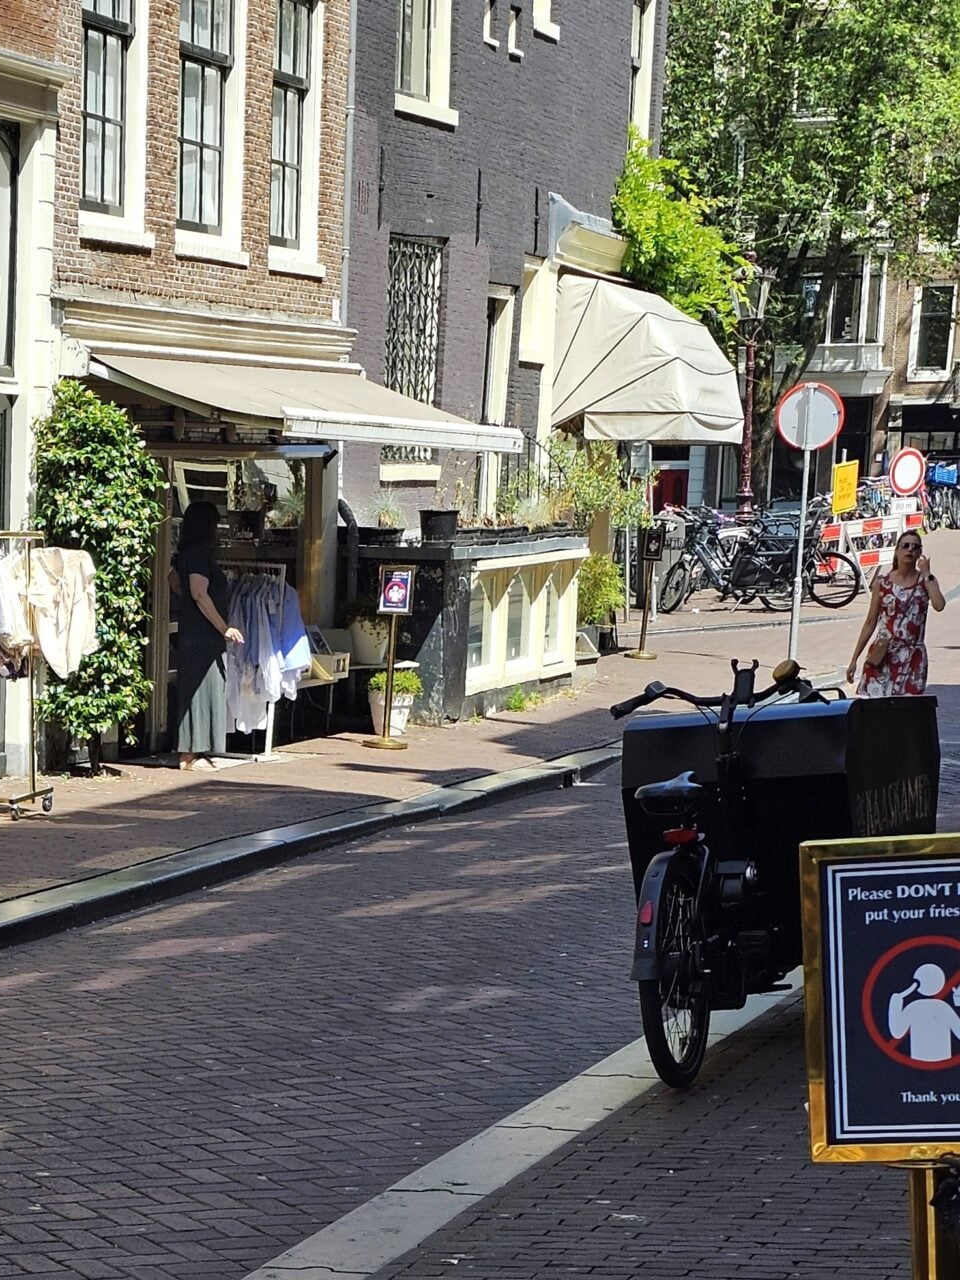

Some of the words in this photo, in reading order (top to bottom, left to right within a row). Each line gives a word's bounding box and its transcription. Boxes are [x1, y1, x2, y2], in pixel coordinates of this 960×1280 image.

[847, 887, 893, 901] Please
[896, 883, 953, 899] DON'T
[865, 908, 889, 925] put
[892, 908, 926, 923] your
[929, 904, 960, 918] fries
[900, 1090, 938, 1103] Thank
